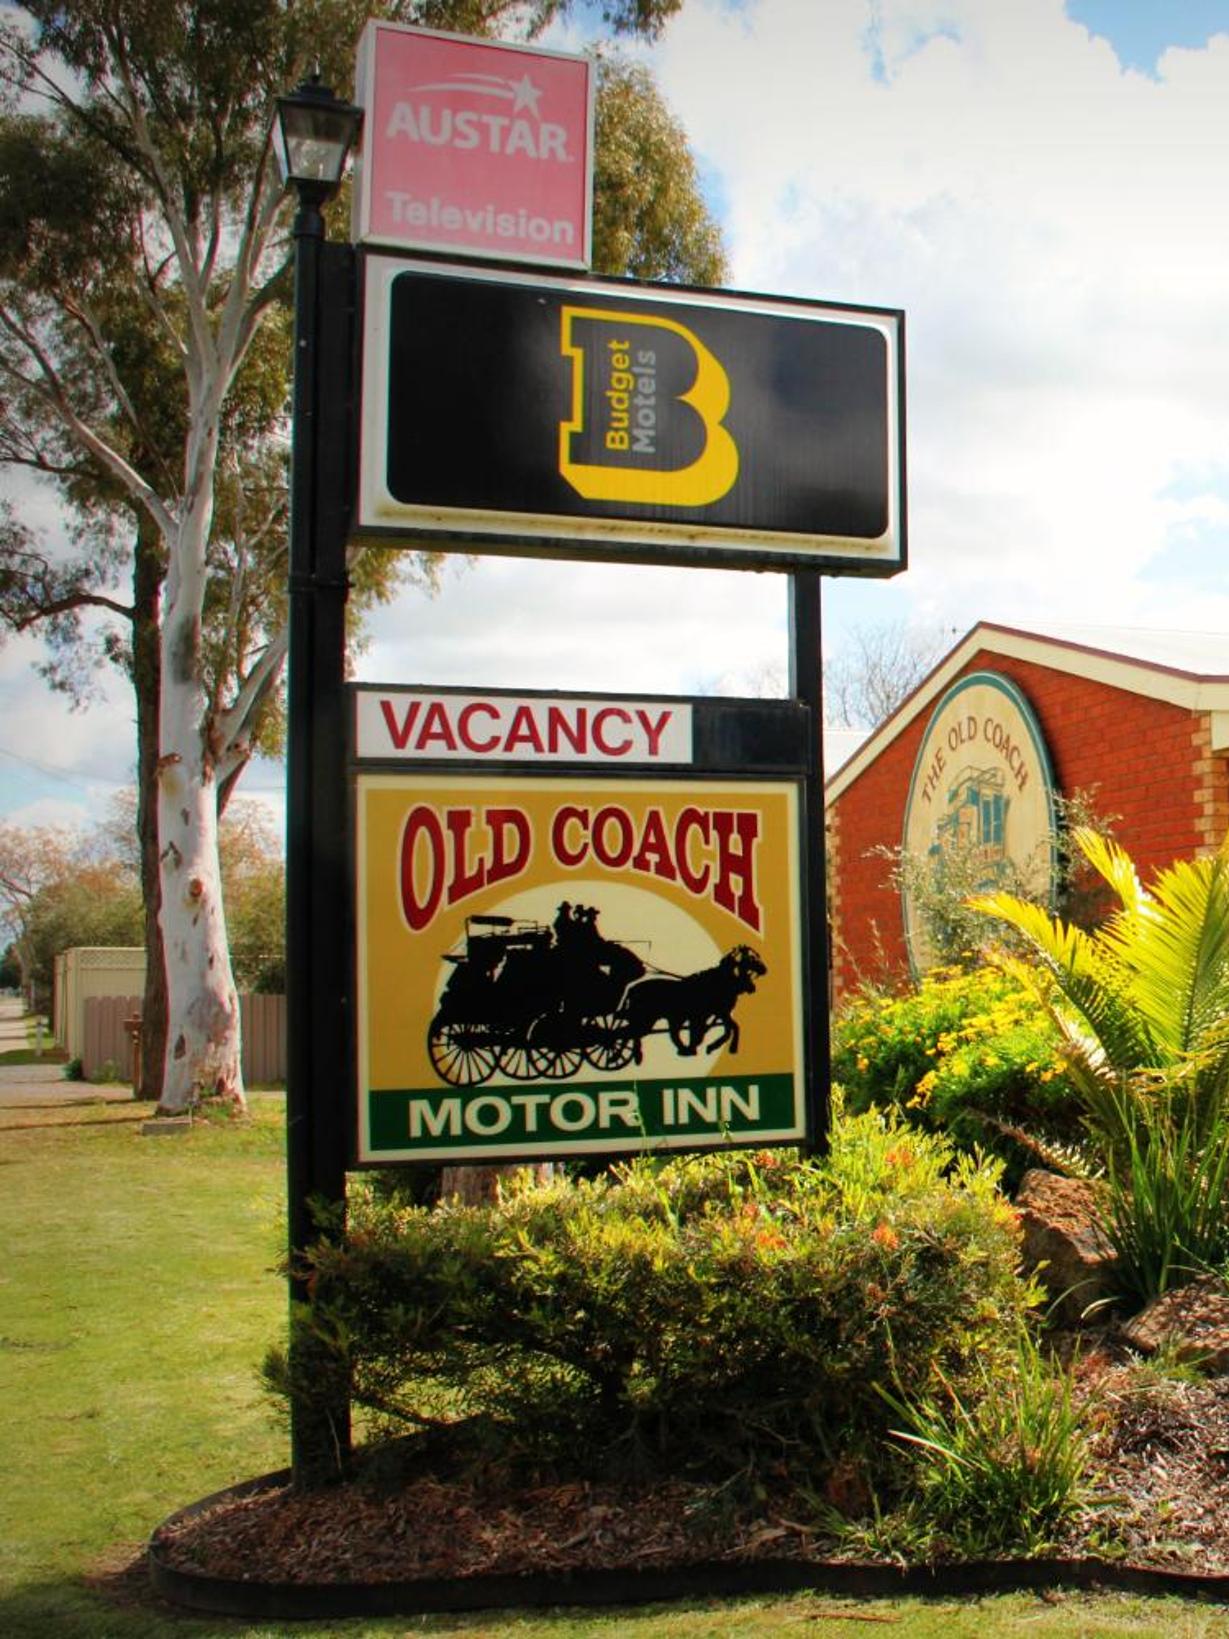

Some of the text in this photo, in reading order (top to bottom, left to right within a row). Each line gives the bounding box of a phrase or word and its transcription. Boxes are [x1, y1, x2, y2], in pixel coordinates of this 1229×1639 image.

[385, 101, 569, 161] AUSTAR
[386, 192, 575, 245] Television
[606, 339, 631, 451] Budget
[632, 350, 656, 453] Motels
[380, 700, 672, 756] VACANCY
[922, 715, 1029, 804] THE OLD COACH
[400, 806, 761, 933] OLD COACH
[408, 1085, 760, 1138] MOTOR INN
